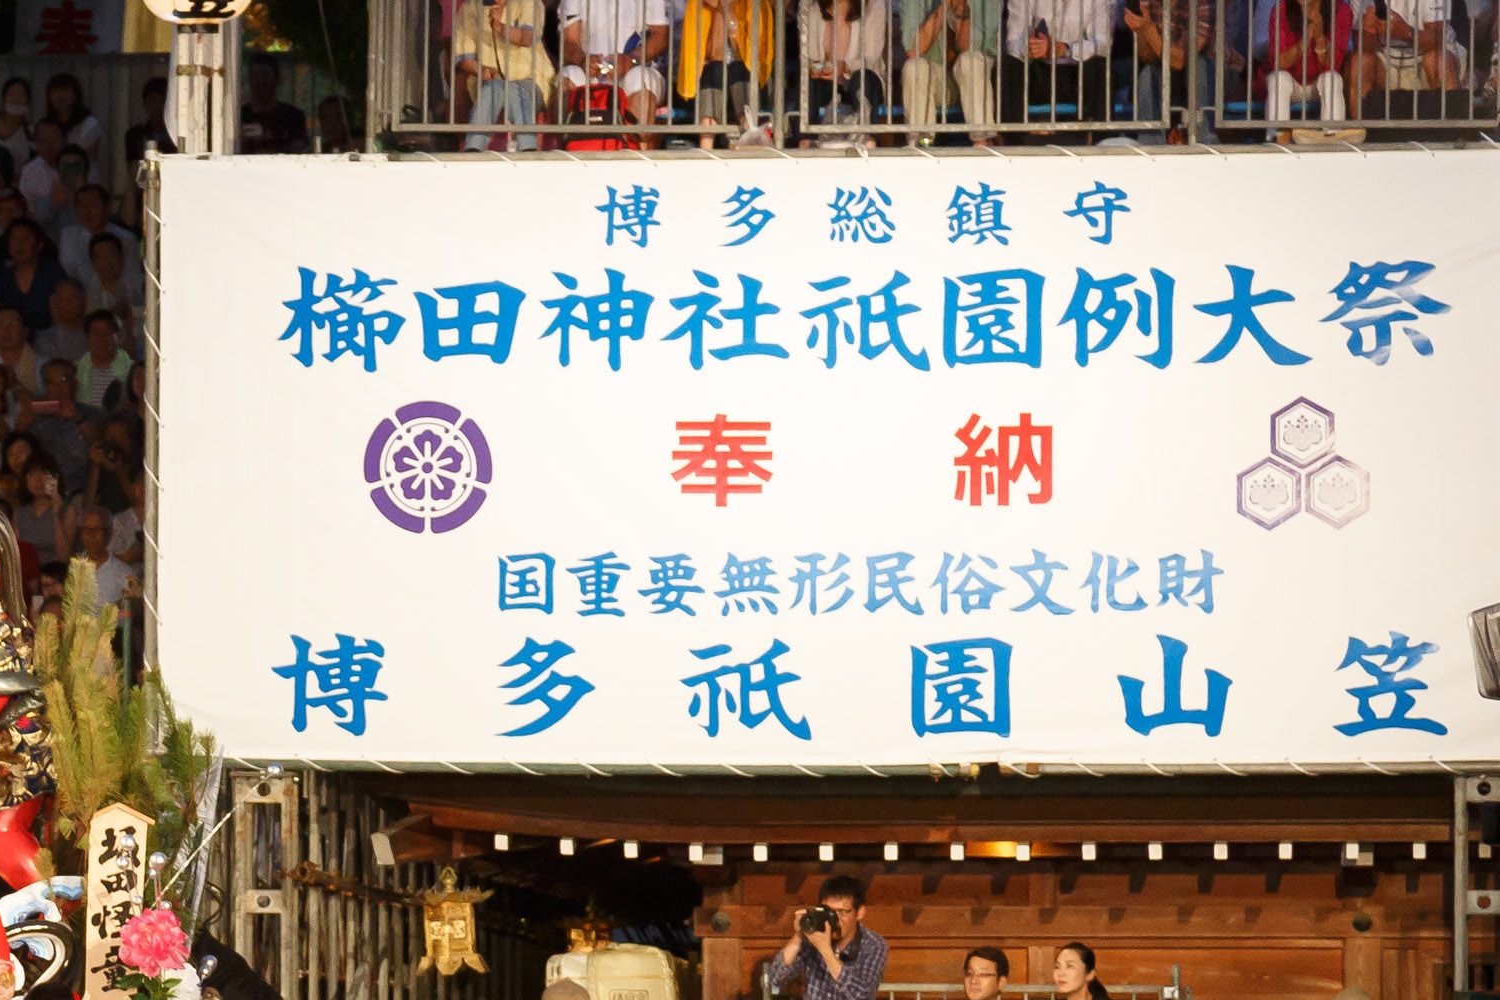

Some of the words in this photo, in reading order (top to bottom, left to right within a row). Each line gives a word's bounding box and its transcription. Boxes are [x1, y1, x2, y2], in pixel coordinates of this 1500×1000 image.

[596, 181, 1132, 250] 博多総鎮守
[279, 260, 1450, 374] 櫛田神社祇園例大祭
[497, 550, 1225, 618] 国重要無形民俗文化財
[273, 632, 1449, 742] 博多祇園山笠
